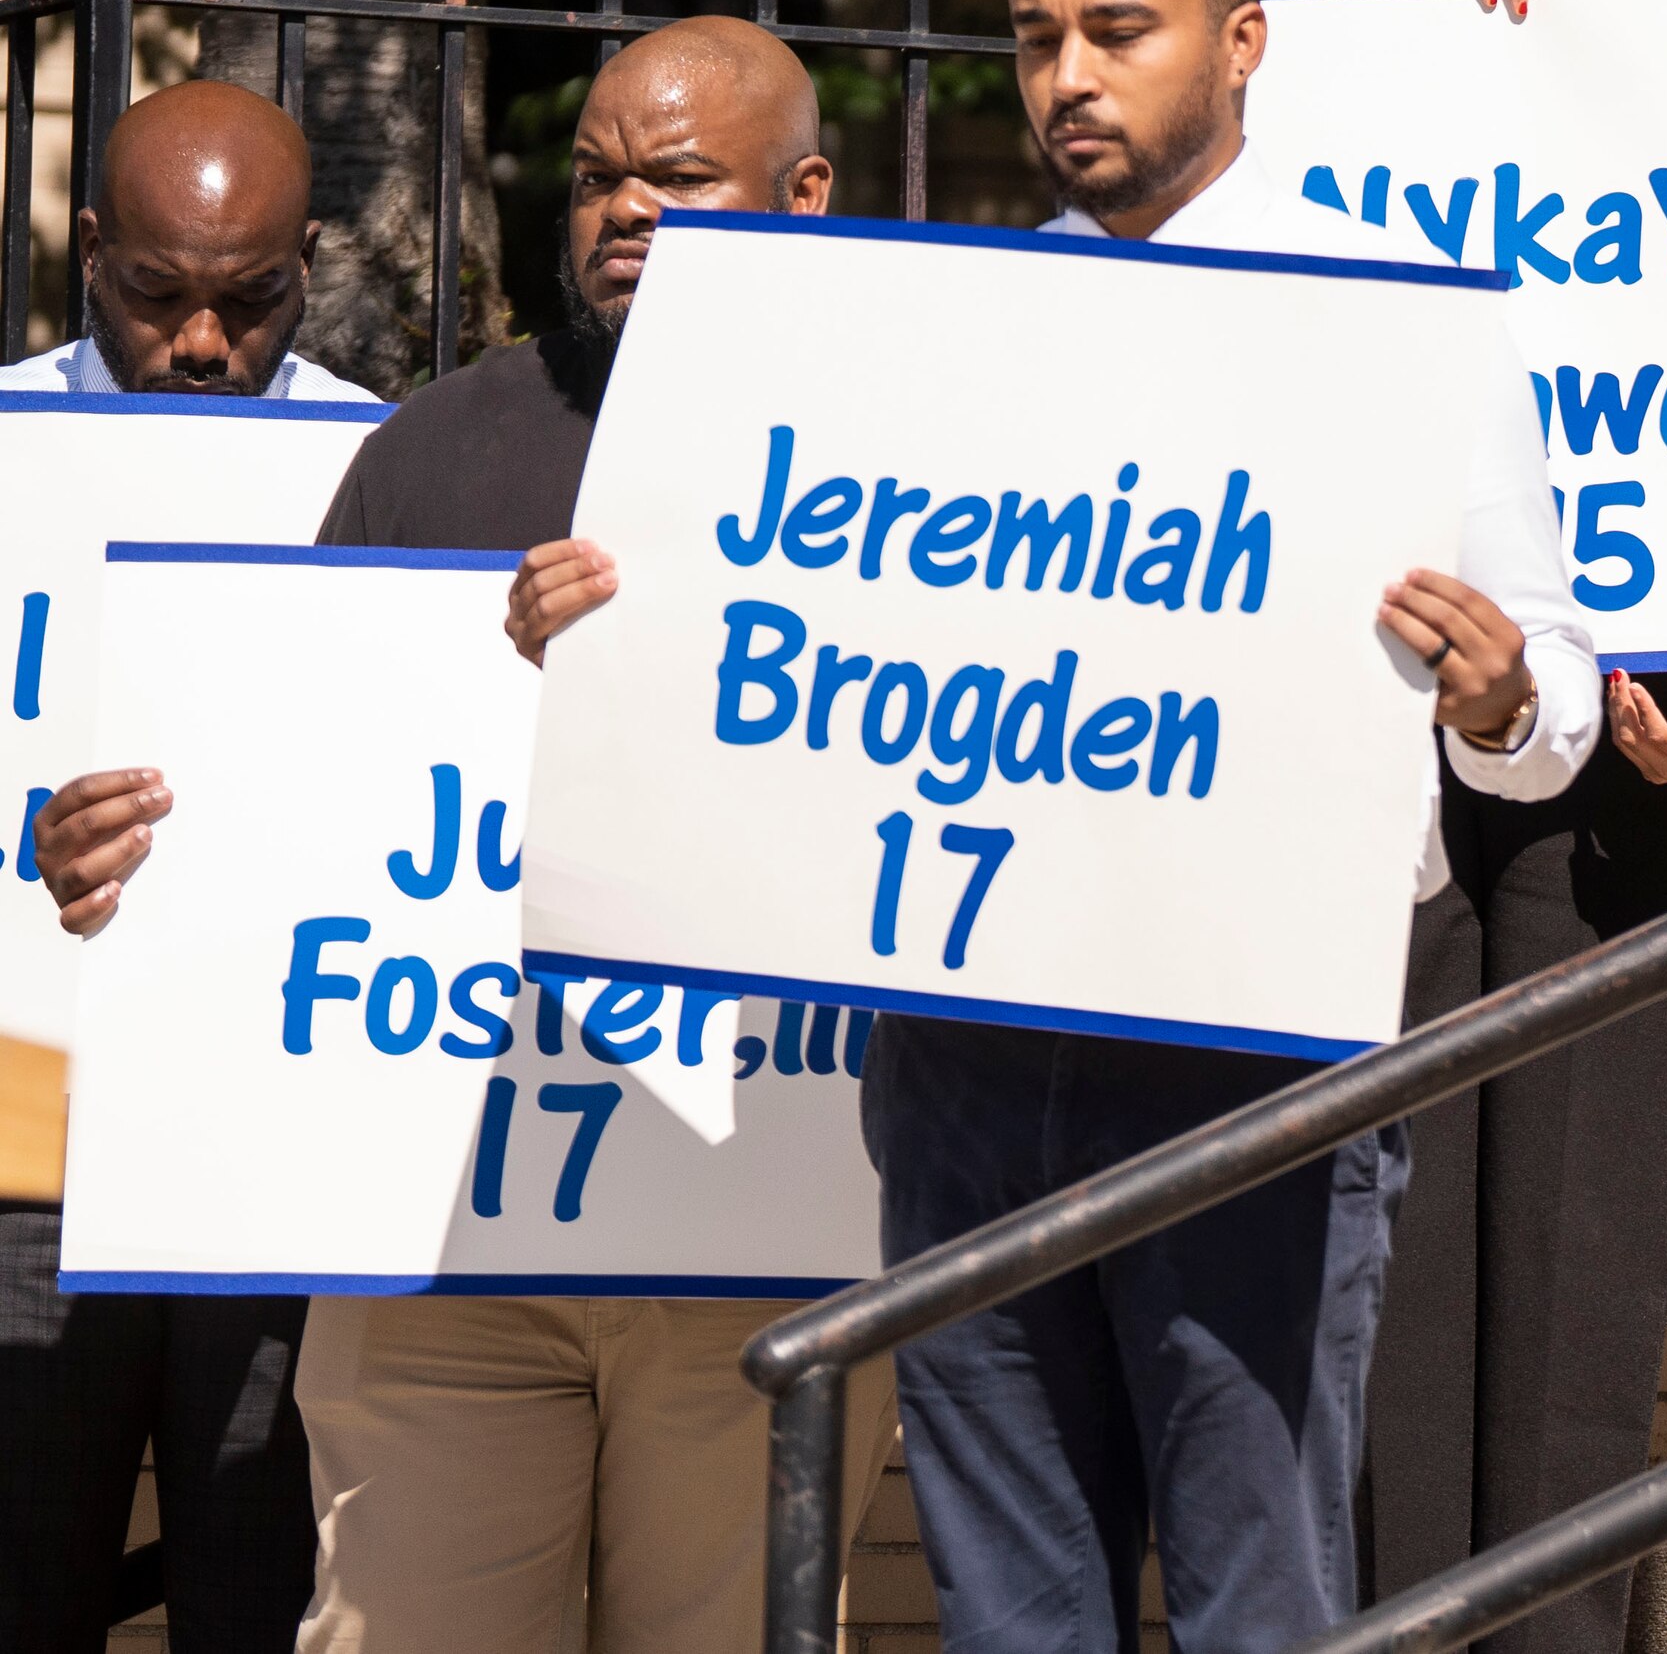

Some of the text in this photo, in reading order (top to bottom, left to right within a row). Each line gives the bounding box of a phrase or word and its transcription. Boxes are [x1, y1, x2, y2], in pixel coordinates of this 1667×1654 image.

[716, 425, 1271, 614] Jeremiah
[1550, 480, 1655, 612] 5
[715, 600, 1220, 806] Brogden
[871, 811, 1015, 970] 17
[472, 1076, 623, 1223] 17
